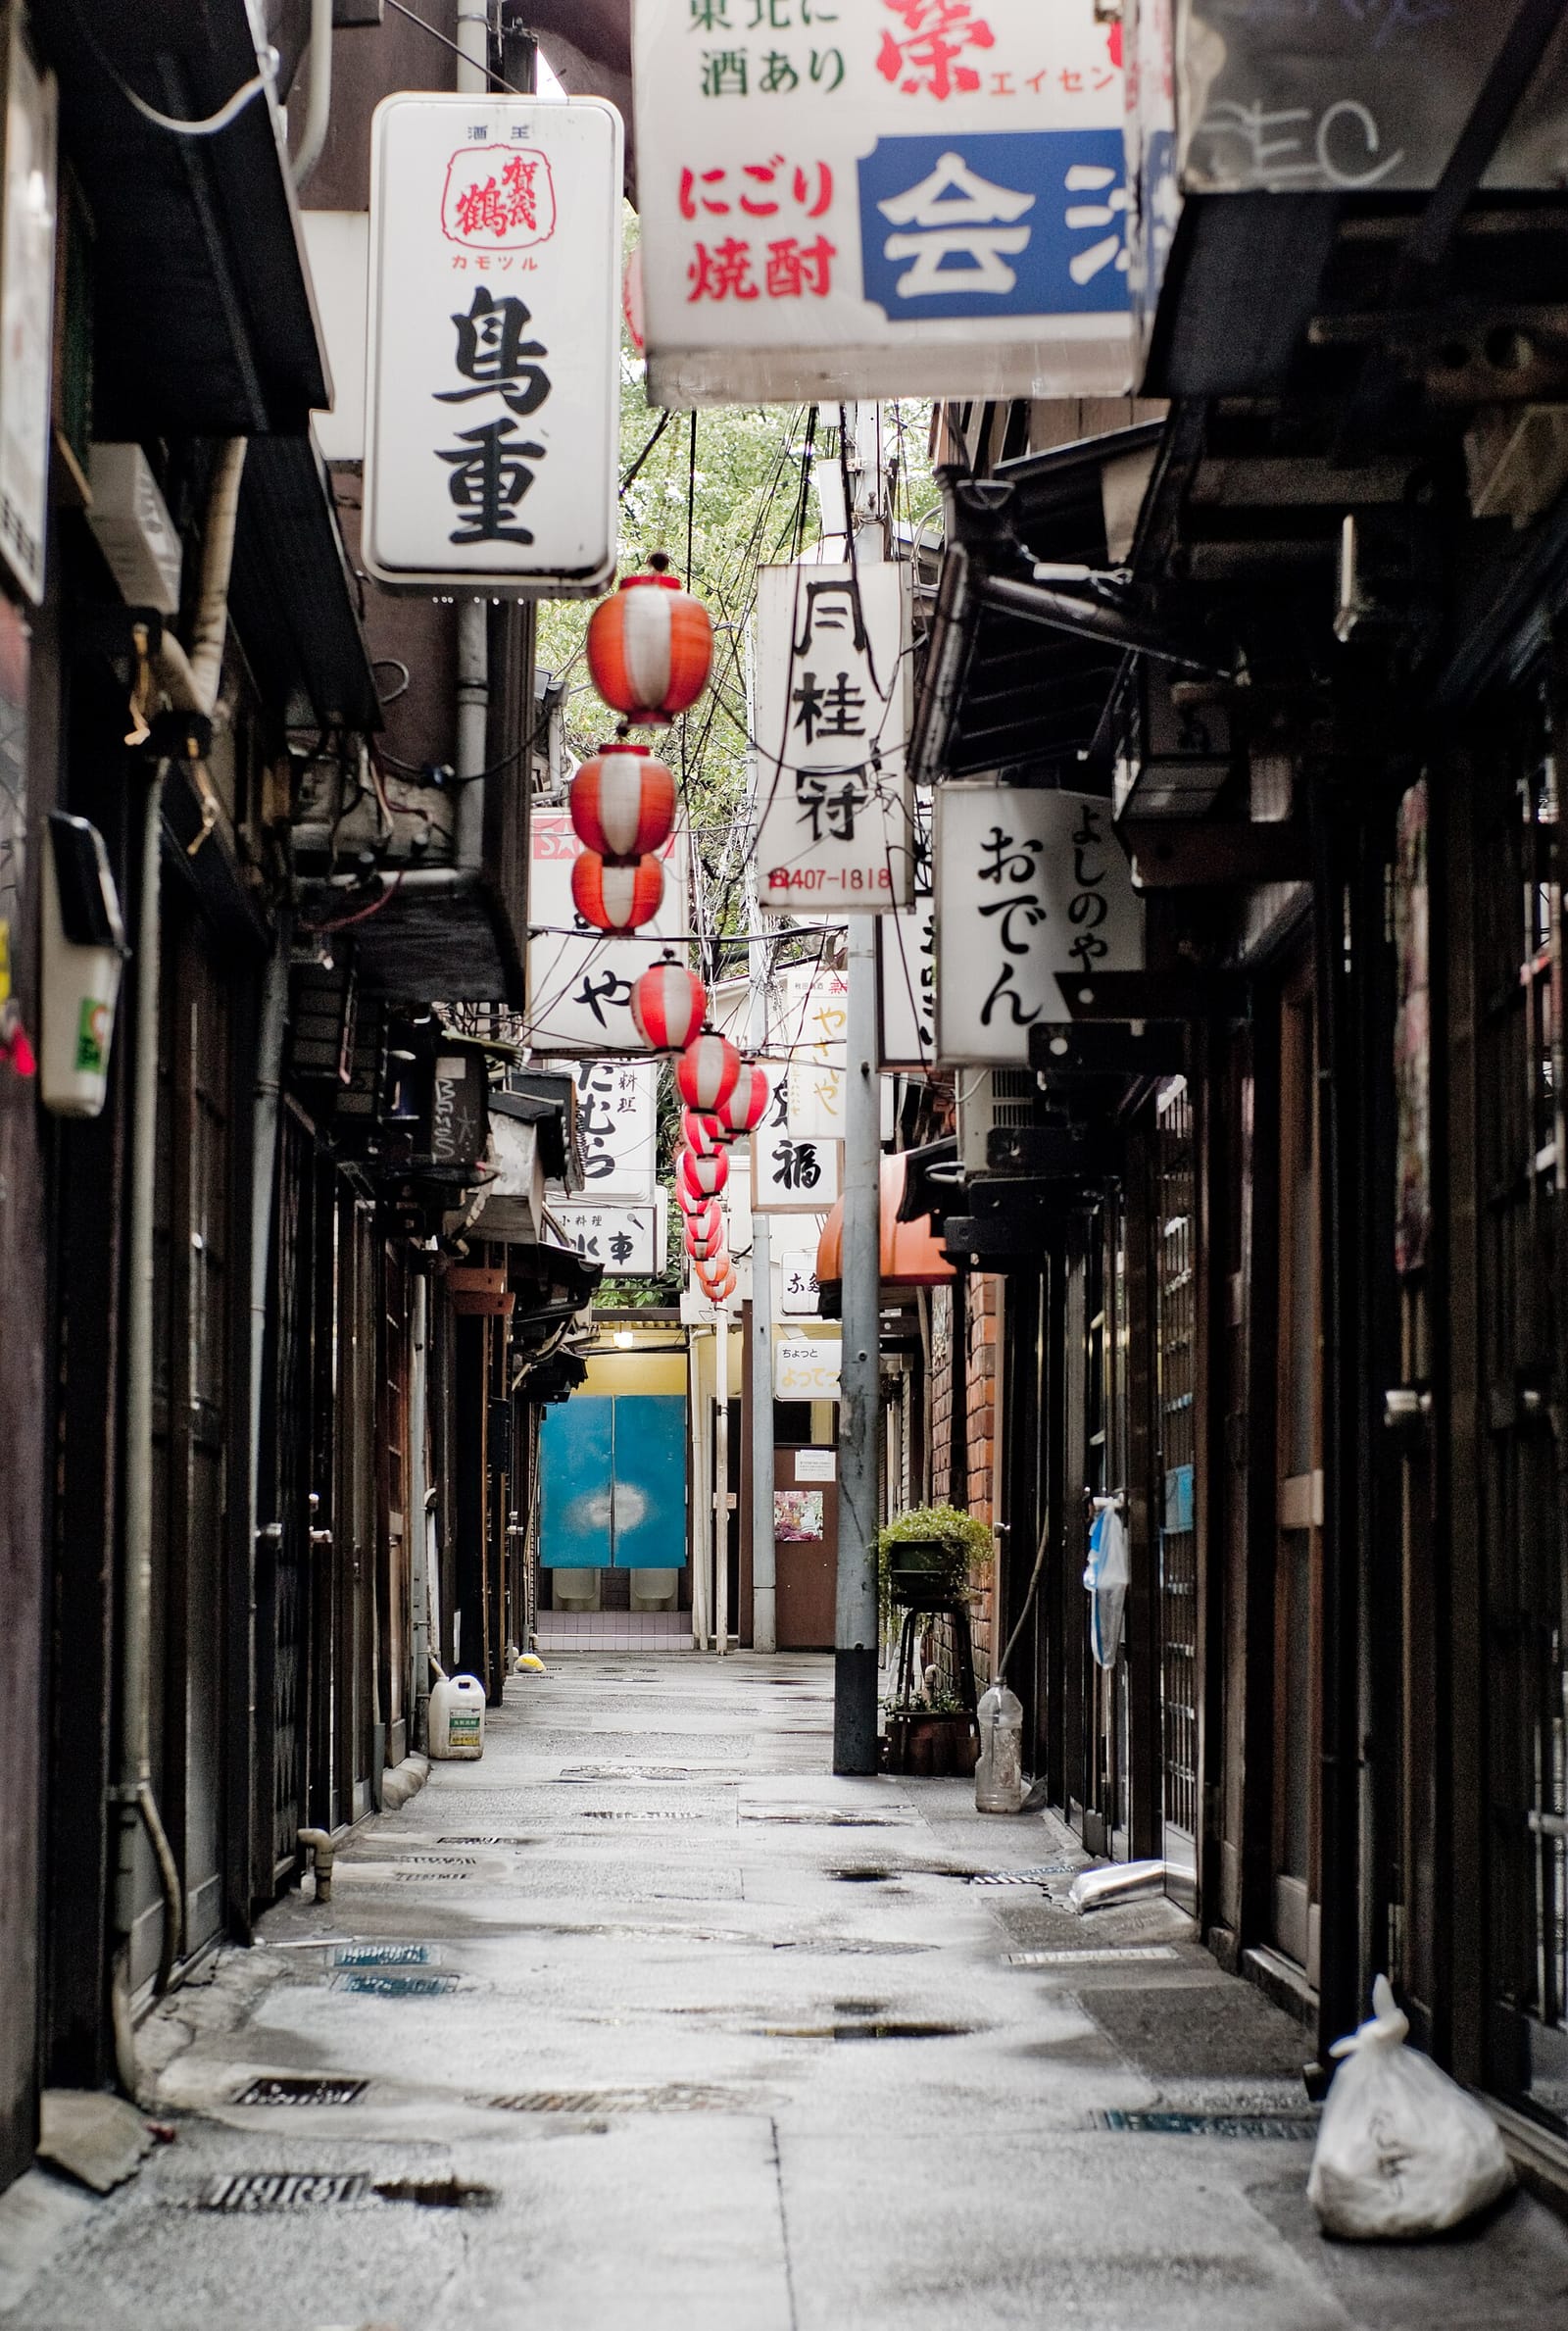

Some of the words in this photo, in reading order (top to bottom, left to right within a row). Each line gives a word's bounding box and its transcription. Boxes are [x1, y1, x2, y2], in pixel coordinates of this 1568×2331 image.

[702, 49, 845, 97] 酒あり
[989, 67, 1115, 96] エイセン
[467, 124, 530, 140] 酒王
[679, 154, 834, 220] にごり
[452, 255, 538, 272] カモツル
[687, 235, 836, 302] 焼酎
[790, 868, 891, 890] 407-1818
[1068, 805, 1108, 972] よしのや
[977, 826, 1047, 1027] おでん
[618, 1058, 638, 1114] 料理
[782, 1349, 819, 1359] ちょっと
